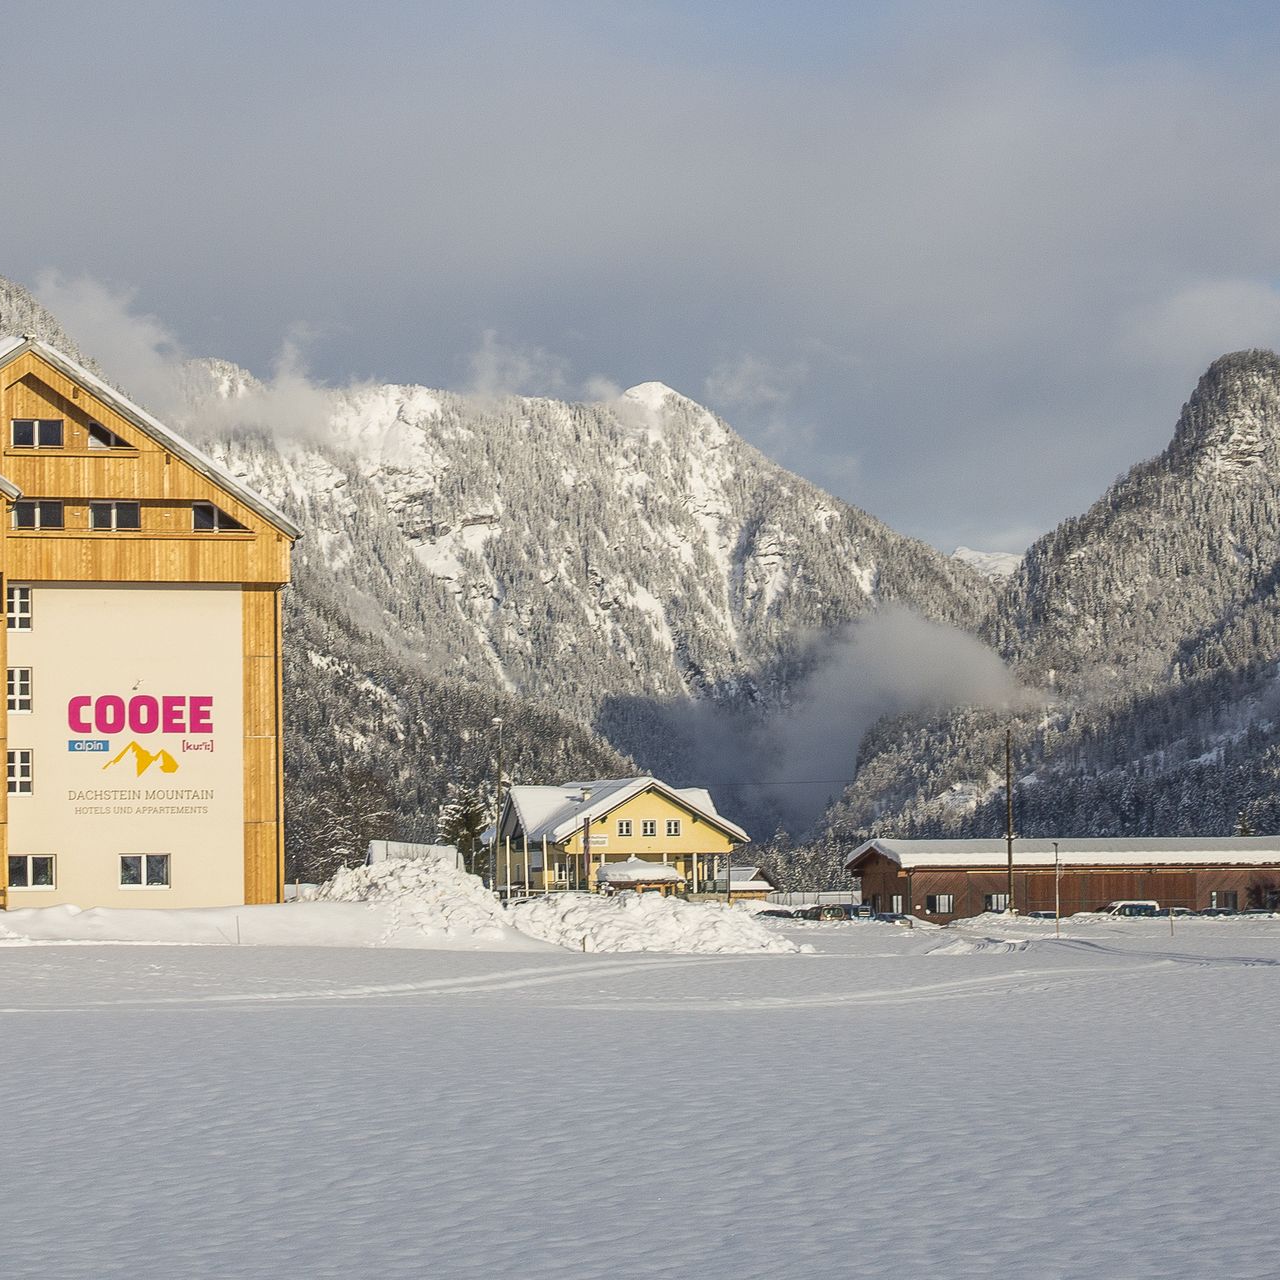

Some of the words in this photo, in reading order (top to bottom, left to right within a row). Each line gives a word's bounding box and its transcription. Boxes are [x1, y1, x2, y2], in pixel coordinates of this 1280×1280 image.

[68, 695, 213, 734] COOEE
[74, 740, 103, 752] alpin
[68, 790, 141, 801] DACHSTEIN
[144, 789, 214, 800] MOUNTAIN
[74, 806, 111, 815] HOTELS
[113, 806, 133, 815] UND
[135, 806, 209, 815] APPARTEMENTS
